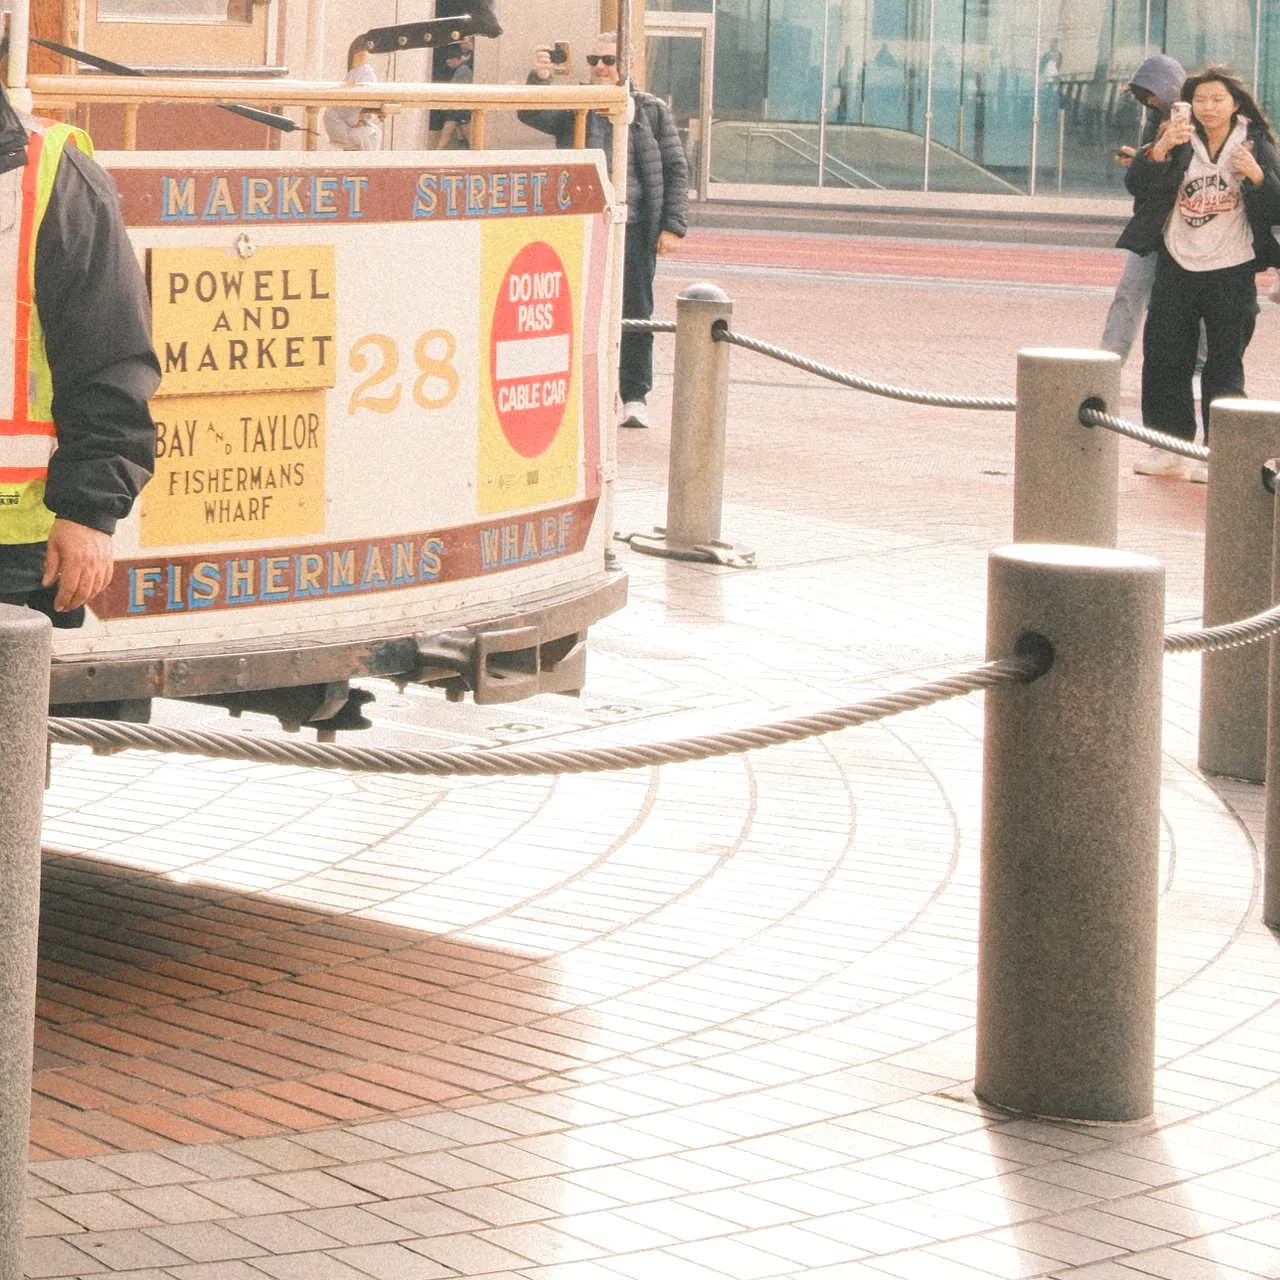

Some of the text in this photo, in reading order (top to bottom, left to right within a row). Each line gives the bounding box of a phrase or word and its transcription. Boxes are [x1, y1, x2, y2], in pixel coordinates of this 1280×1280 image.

[160, 174, 369, 221] MARKET
[413, 171, 548, 218] STREET
[168, 269, 330, 305] POWELL
[509, 271, 562, 302] DO NOT
[213, 306, 290, 332] AND
[517, 303, 553, 332] PASS
[165, 335, 332, 373] MARKET
[348, 329, 460, 415] 28
[498, 379, 566, 413] CABLE CAR
[154, 420, 197, 460] BAY
[240, 413, 319, 453] TAYLOR
[168, 463, 304, 496] FISHERMANS
[204, 497, 273, 524] WHARF
[127, 512, 575, 613] FISHERMANS WHARF
